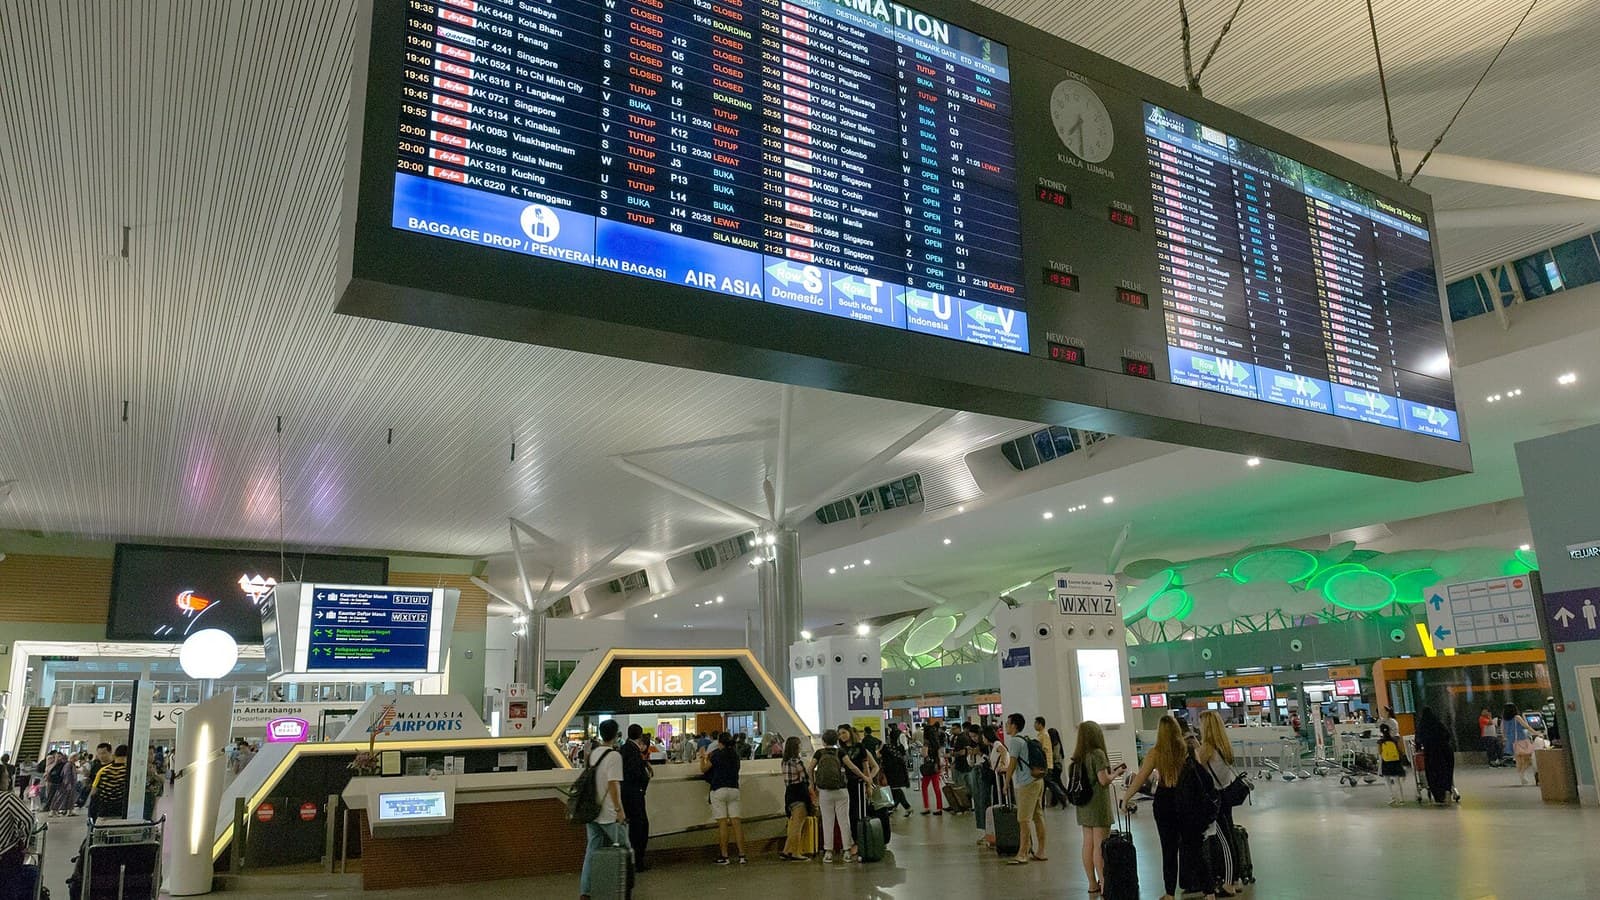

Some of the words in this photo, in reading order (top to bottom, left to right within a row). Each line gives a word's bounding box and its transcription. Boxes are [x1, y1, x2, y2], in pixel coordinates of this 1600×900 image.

[835, 9, 878, 29] DESTINATION
[915, 38, 940, 53] REMARK
[941, 48, 956, 59] GATE
[408, 0, 434, 15] 19:35
[517, 32, 548, 50] Penang
[629, 67, 663, 83] CLOSED
[671, 80, 683, 91] K4
[713, 92, 752, 111] BOARDING
[408, 18, 433, 33] 19:40
[476, 38, 489, 50] QF
[491, 41, 512, 56] 4241
[516, 50, 559, 69] Singapore
[629, 84, 656, 97] TUTUP
[713, 108, 738, 121] TUTUP
[407, 35, 432, 50] 19:40
[489, 57, 511, 71] 0524
[515, 66, 528, 78] Ho
[530, 69, 545, 82] Chi
[546, 73, 565, 88] Minh
[567, 78, 583, 94] City
[629, 99, 652, 112] BUKA
[671, 112, 686, 123] L11
[692, 117, 712, 129] 20:50
[713, 123, 739, 137] LEWAT
[405, 53, 431, 67] 19:40
[515, 81, 524, 92] P.
[526, 85, 565, 104] Langkawi
[628, 114, 656, 128] TUTUP
[671, 127, 688, 139] K12
[713, 138, 738, 151] TUTUP
[404, 69, 430, 84] 19:45
[488, 91, 509, 105] 0721
[514, 99, 556, 118] Singapore
[628, 130, 656, 144] TUTUP
[671, 143, 687, 154] L16
[691, 148, 712, 159] 20:30
[713, 153, 740, 167] LEWAT
[402, 87, 429, 101] 19:45
[486, 107, 508, 122] 5134
[524, 118, 560, 136] Kinabalu
[627, 146, 655, 160] TUTUP
[670, 158, 682, 168] J3
[713, 168, 734, 181] BUKA
[401, 104, 427, 118] 19:55
[486, 125, 508, 139] 0083
[512, 132, 576, 156] Visakhapatnam
[627, 162, 655, 175] TUTUP
[670, 174, 688, 185] P13
[713, 183, 734, 195] BUKA
[763, 123, 781, 135] 21:00
[840, 146, 868, 160] Colombo
[921, 170, 939, 182] OPEN
[952, 179, 964, 190] L13
[1057, 153, 1083, 168] KUALA
[400, 123, 426, 138] 20:00
[485, 143, 507, 157] 0395
[512, 151, 536, 166] Kuala
[538, 157, 563, 171] Namu
[627, 180, 655, 193] TUTUP
[670, 191, 687, 202] L14
[713, 201, 734, 213] BUKA
[398, 141, 425, 156] 20:00
[484, 160, 506, 174] 5218
[511, 168, 545, 184] Kuching
[627, 196, 650, 208] BUKA
[670, 207, 686, 218] J14
[691, 211, 712, 223] 20:35
[713, 216, 740, 229] LEWAT
[1038, 177, 1067, 192] SYDNEY
[397, 159, 424, 173] 20:00
[483, 177, 505, 192] 6220
[510, 185, 520, 195] K.
[522, 188, 571, 207] Terengganu
[627, 212, 655, 225] TUTUP
[713, 232, 730, 244] SILA
[731, 236, 759, 249] MASUK
[763, 182, 782, 193] 21:10
[924, 225, 942, 235] OPEN
[408, 217, 480, 242] BAGGAGE
[483, 233, 522, 250] DROP
[531, 243, 619, 270] PENYERAHAN
[621, 261, 666, 279] BAGASI
[685, 269, 716, 289] AIR
[721, 277, 762, 298] ASIA
[764, 228, 783, 240] 21:25
[843, 248, 874, 261] Singapore
[926, 267, 944, 277] OPEN
[988, 281, 1015, 294] DELAYED
[764, 243, 783, 255] 21:25
[843, 262, 869, 276] Kuching
[927, 281, 944, 292] OPEN
[1049, 260, 1072, 273] TAIPEI
[776, 269, 801, 283] Row
[802, 264, 822, 293] S
[842, 283, 866, 296] Row
[863, 277, 883, 305] T
[771, 287, 824, 306] Domestic
[838, 298, 859, 310] South
[860, 303, 883, 314] Korea
[932, 293, 951, 319] U
[849, 311, 873, 321] Japan
[908, 315, 949, 331] Indonesia
[975, 310, 996, 323] Row
[997, 307, 1014, 334] V
[1216, 357, 1234, 381] W
[1294, 375, 1307, 396] X
[244, 706, 301, 714] Antarabangsa
[398, 711, 463, 719] MALAYSIA
[638, 698, 654, 707] Next
[655, 698, 691, 706] Generation
[691, 698, 706, 706] Hub
[391, 720, 462, 732] AIRPORTS
